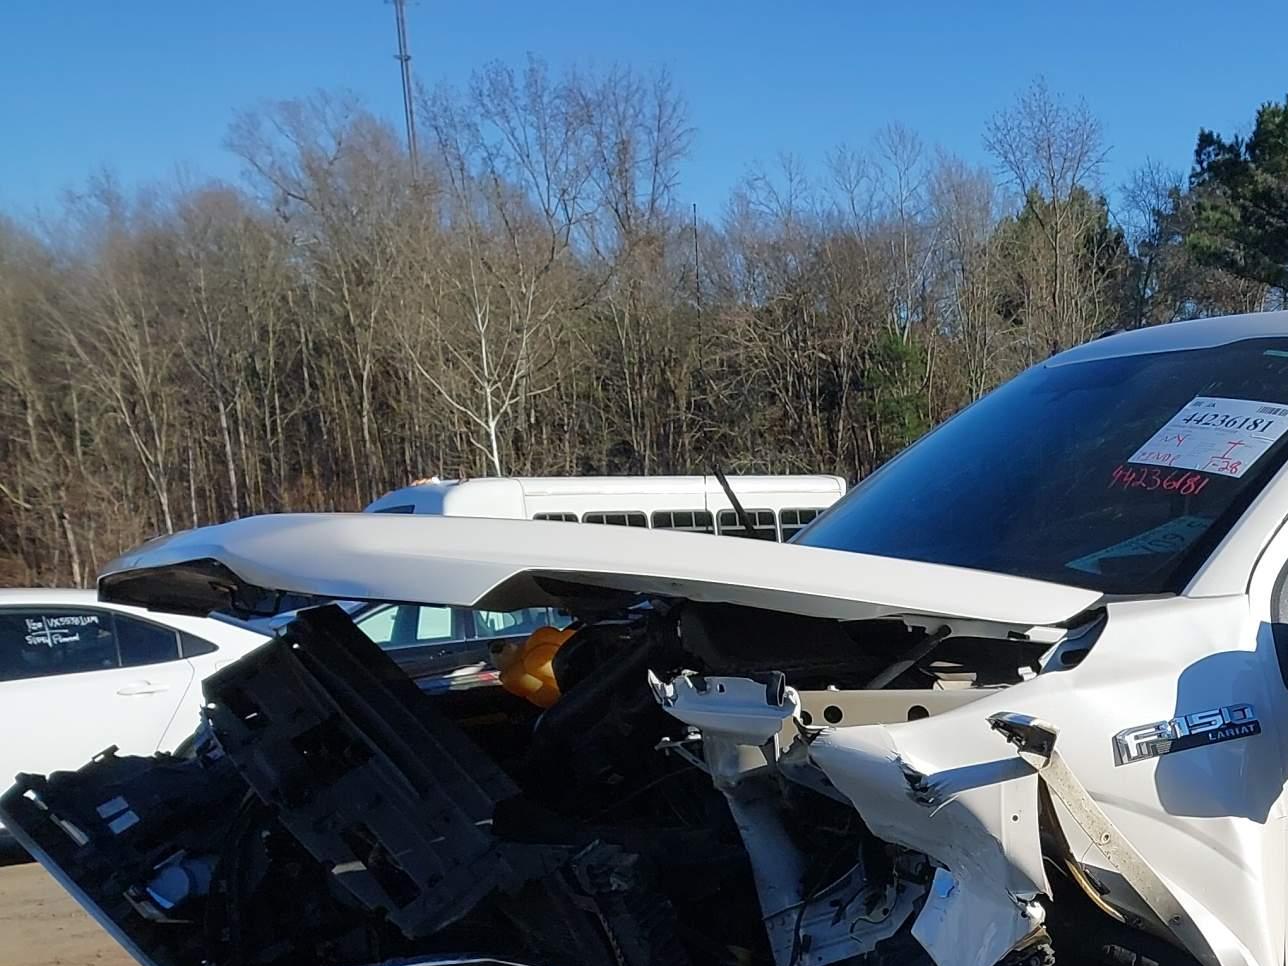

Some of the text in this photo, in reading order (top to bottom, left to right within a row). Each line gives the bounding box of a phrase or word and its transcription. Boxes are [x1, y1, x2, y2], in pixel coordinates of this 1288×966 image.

[1182, 411, 1274, 433] 44236181
[1108, 464, 1209, 495] 44236181
[1208, 724, 1256, 741] LARIAT
